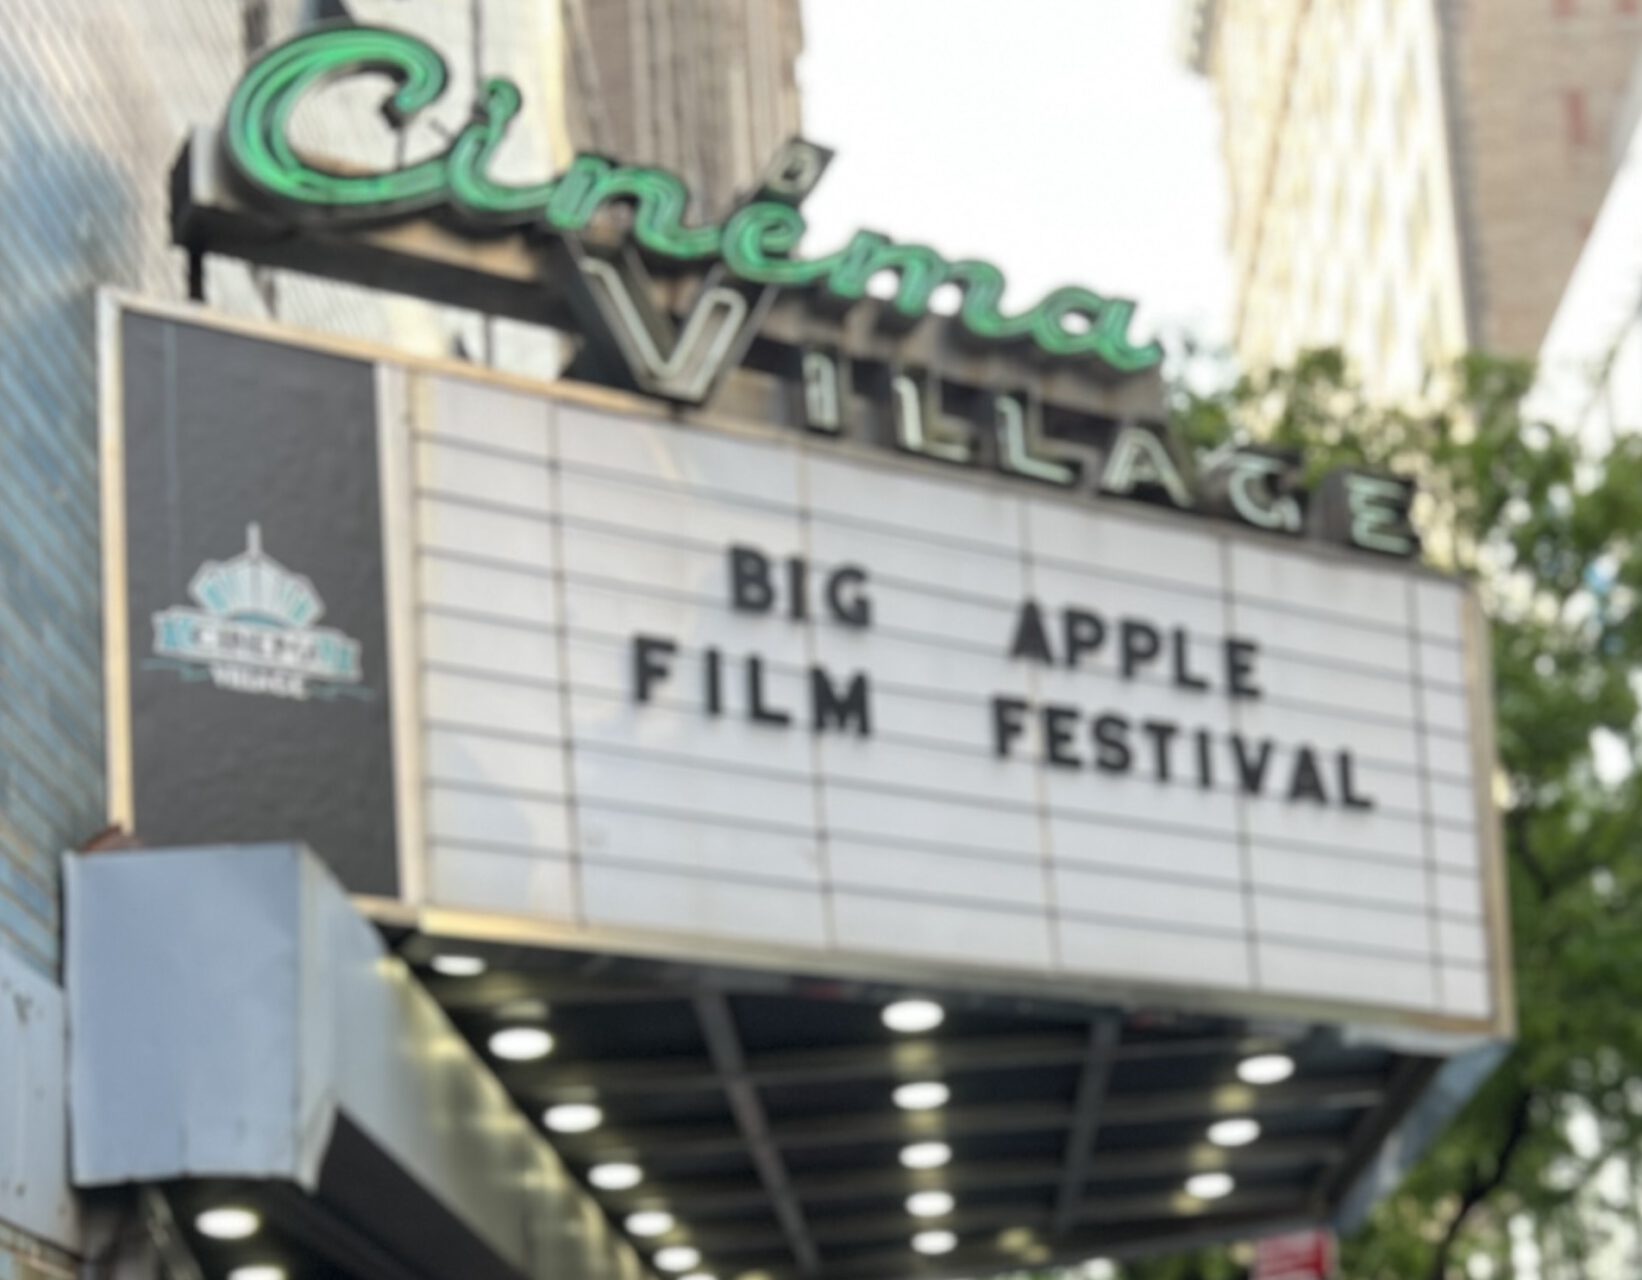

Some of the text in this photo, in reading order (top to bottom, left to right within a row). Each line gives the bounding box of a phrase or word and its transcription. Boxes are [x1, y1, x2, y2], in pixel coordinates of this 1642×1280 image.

[574, 250, 1418, 556] VILLAGE
[728, 543, 1263, 701] BIG APPLE
[632, 634, 1377, 812] FILM FESTIVAL
